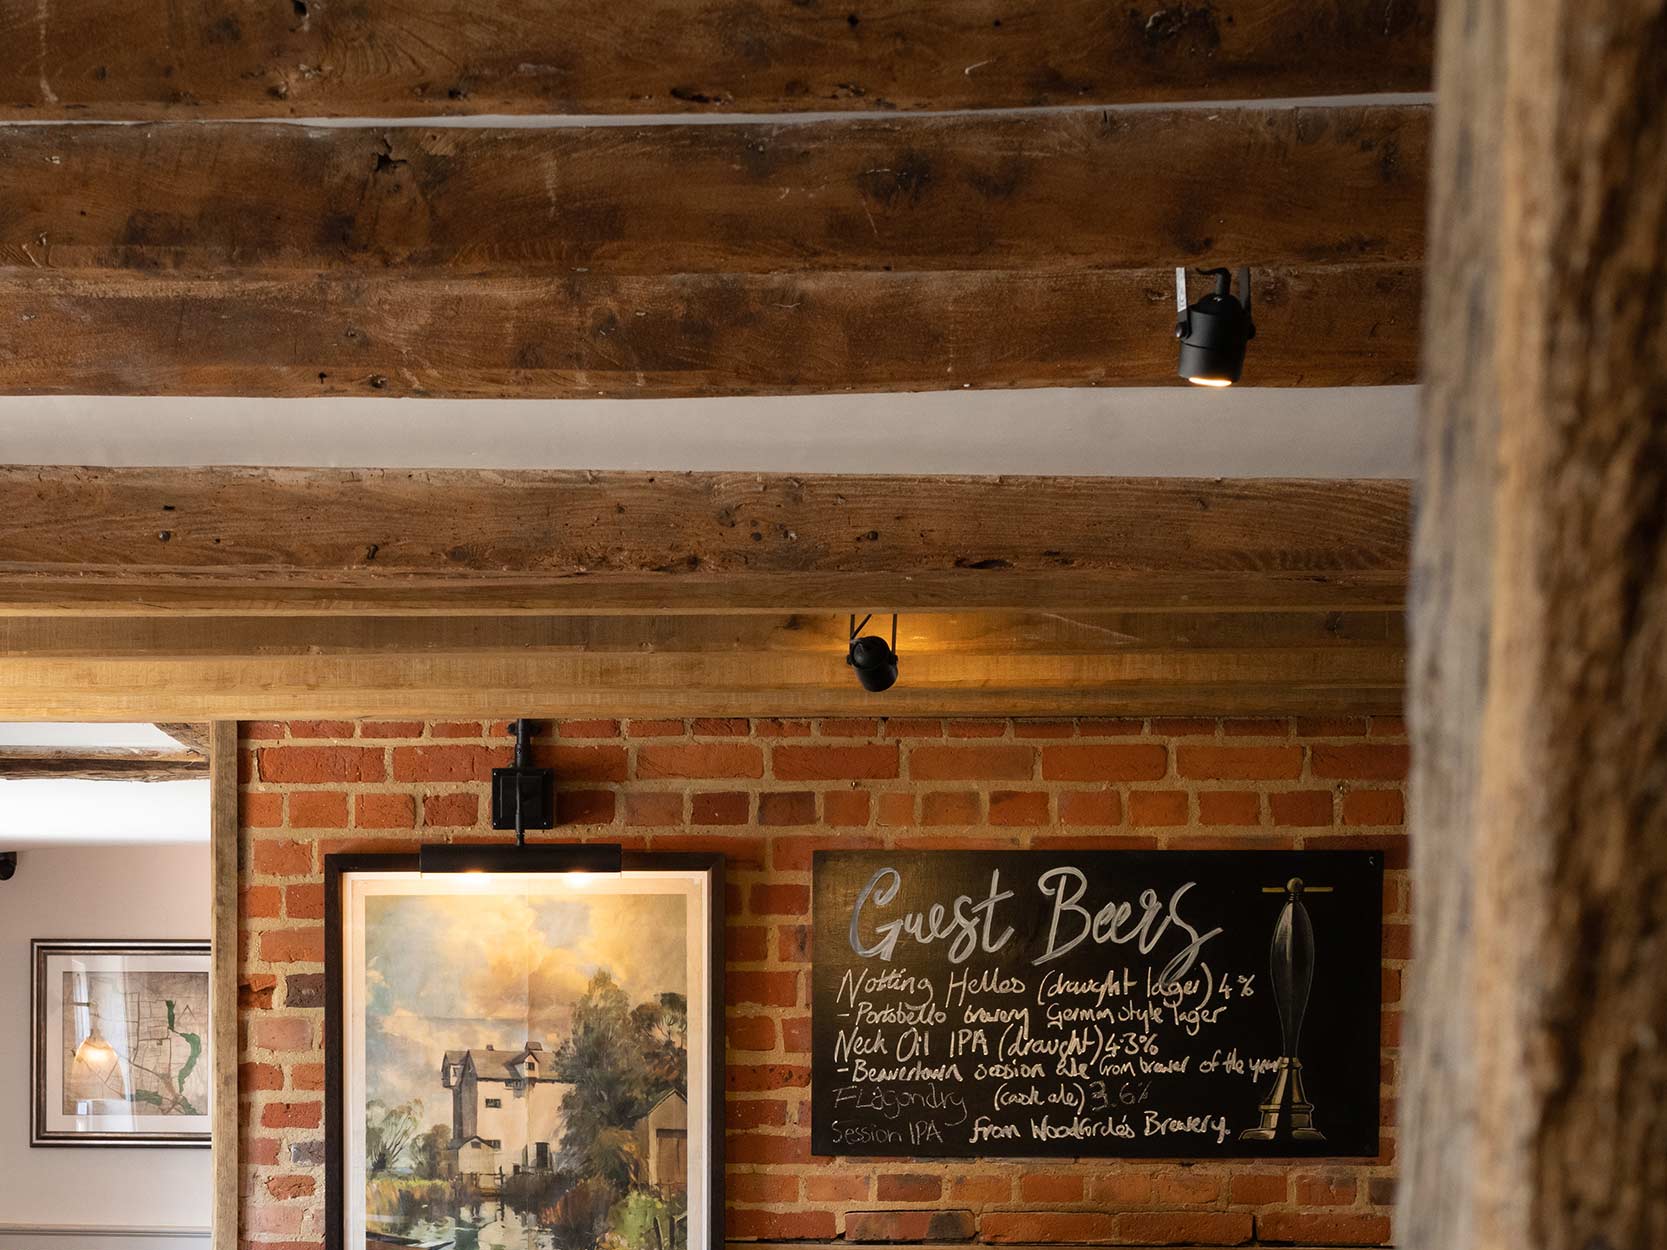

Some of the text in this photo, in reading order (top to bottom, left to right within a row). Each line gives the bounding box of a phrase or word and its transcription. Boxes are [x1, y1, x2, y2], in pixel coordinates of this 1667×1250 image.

[849, 867, 1224, 986] Guest Beers
[836, 968, 934, 1010] Notting
[964, 1005, 1030, 1041] brewery
[1046, 1003, 1115, 1030] German
[1118, 1000, 1164, 1034] style
[1172, 1001, 1228, 1037] lager
[834, 1027, 888, 1063] Neck
[896, 1027, 930, 1063] Oil
[949, 1028, 989, 1059] IPA
[973, 1060, 1046, 1081] session
[1099, 1054, 1136, 1078] from
[1198, 1049, 1222, 1074] of
[1222, 1047, 1245, 1075] the
[1047, 1082, 1086, 1116] ale)
[831, 1120, 903, 1145] Session
[908, 1118, 944, 1145] IPA
[968, 1116, 1022, 1144] from
